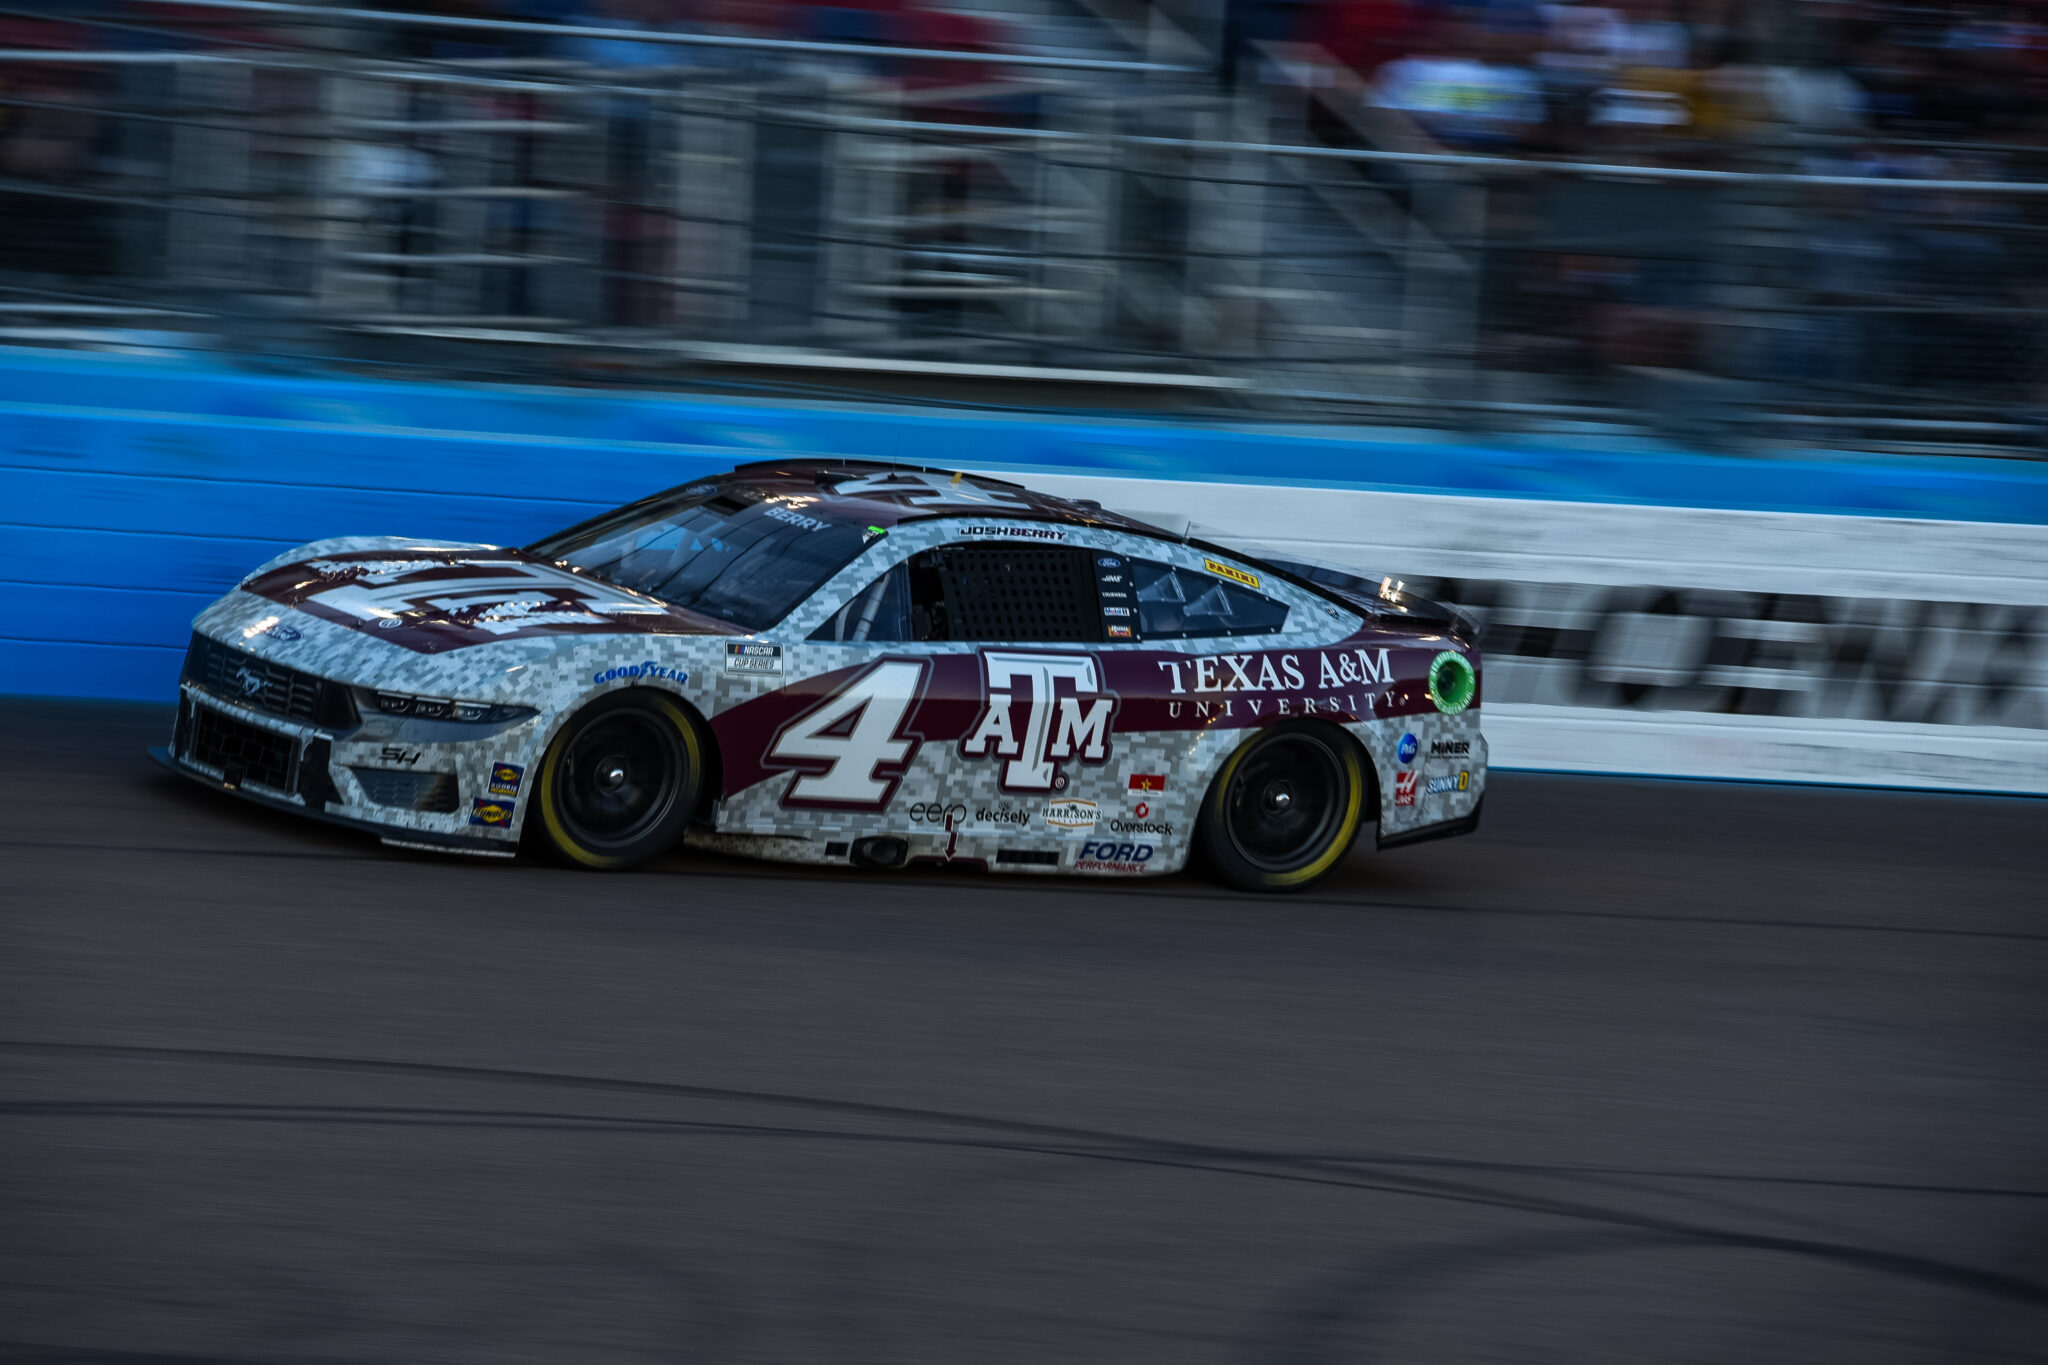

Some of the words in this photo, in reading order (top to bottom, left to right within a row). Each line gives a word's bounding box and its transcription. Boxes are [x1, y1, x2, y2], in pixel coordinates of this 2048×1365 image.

[763, 507, 832, 532] BERRY
[1208, 562, 1256, 585] PANINI
[743, 645, 774, 656] NASCAR
[593, 660, 689, 685] GOODYEAR
[733, 658, 749, 668] CUP
[749, 658, 775, 670] SERIES
[1159, 653, 1305, 695] TEXAS
[1318, 648, 1395, 690] A&M
[1169, 691, 1395, 719] UNIVERSITY
[768, 660, 925, 804] 4
[1431, 741, 1469, 754] MINER
[494, 769, 520, 780] SUNOCO
[473, 807, 512, 820] SUNOCO
[909, 802, 967, 824] eero
[976, 807, 1030, 826] decisely
[1042, 807, 1102, 821] HARRISON'S
[1110, 820, 1173, 836] Overstock
[1079, 842, 1154, 863] FORD
[1074, 860, 1147, 874] PERFORMANCE
